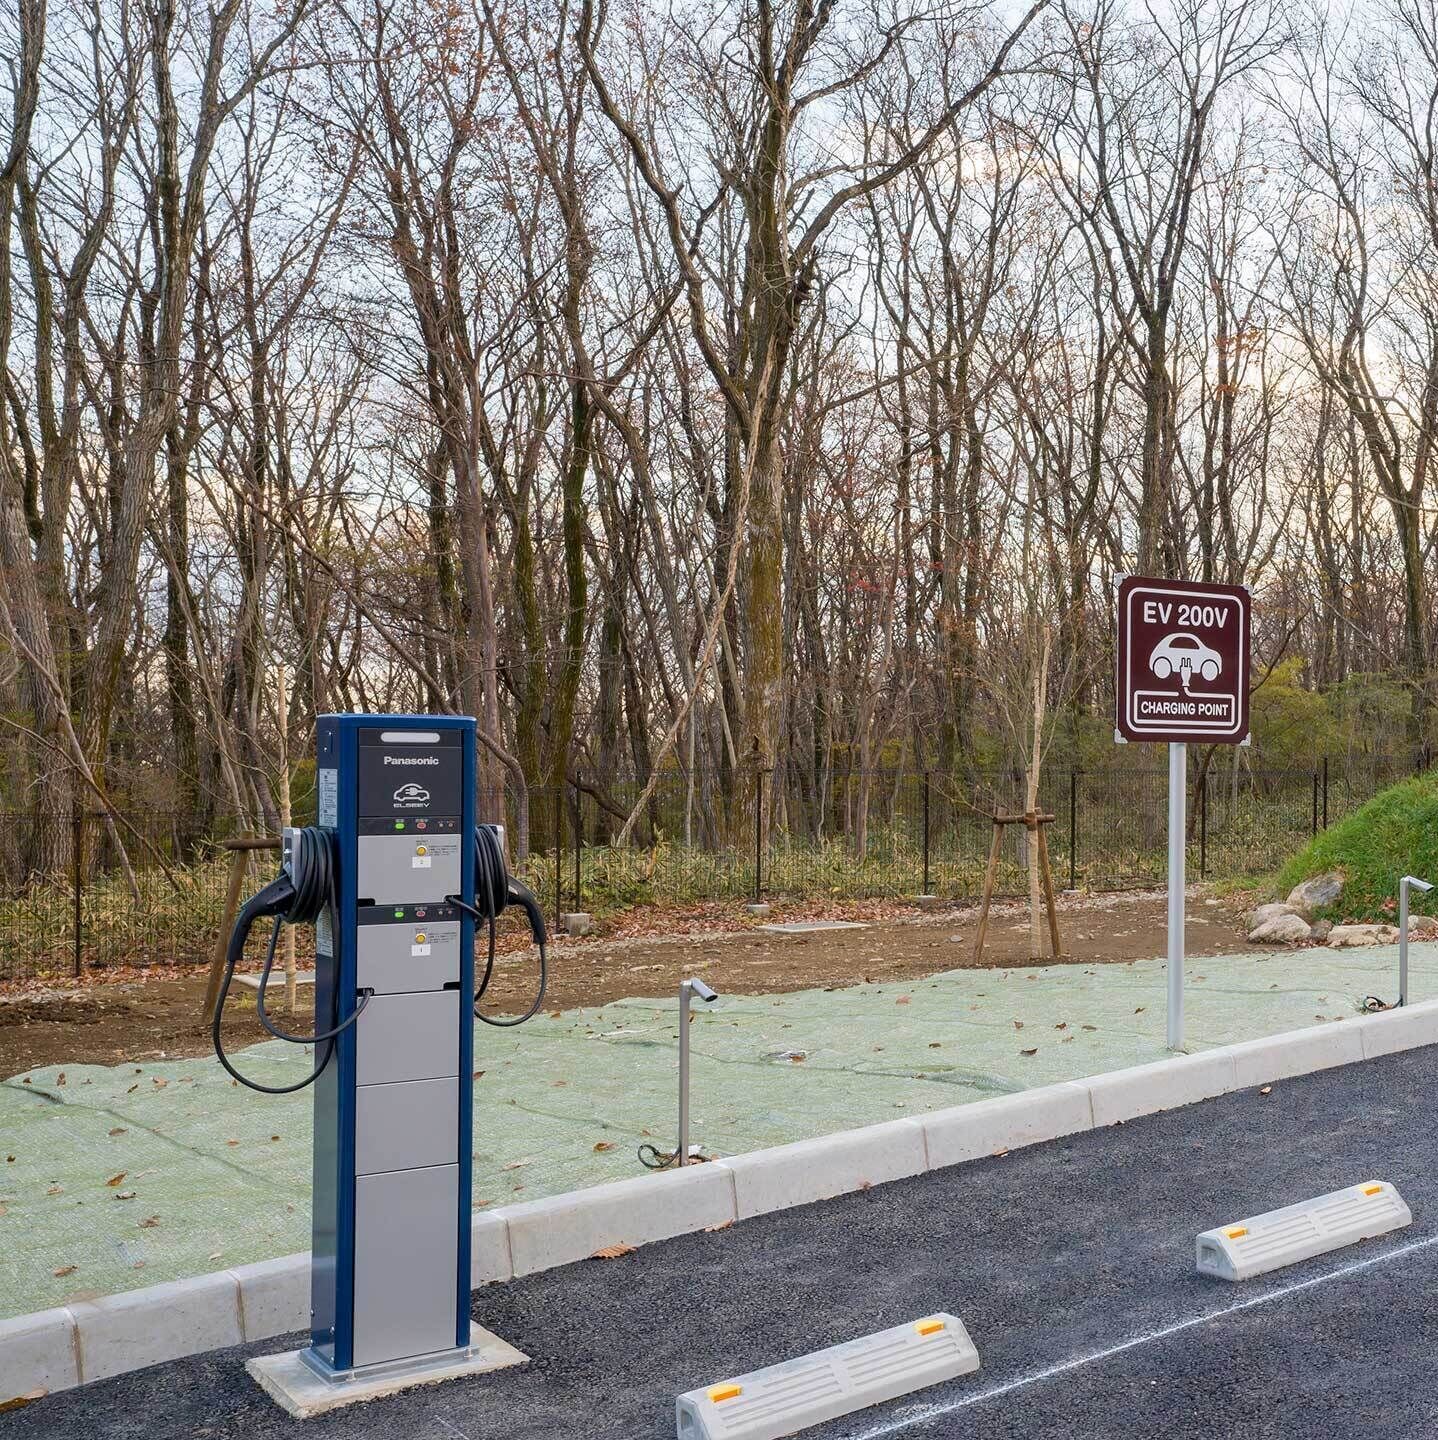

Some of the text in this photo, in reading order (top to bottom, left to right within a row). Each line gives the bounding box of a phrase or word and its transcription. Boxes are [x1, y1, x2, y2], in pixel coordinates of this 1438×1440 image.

[1143, 601, 1229, 629] EV 200V
[1140, 701, 1229, 716] CHARGING POINT
[383, 756, 440, 765] Panasonic
